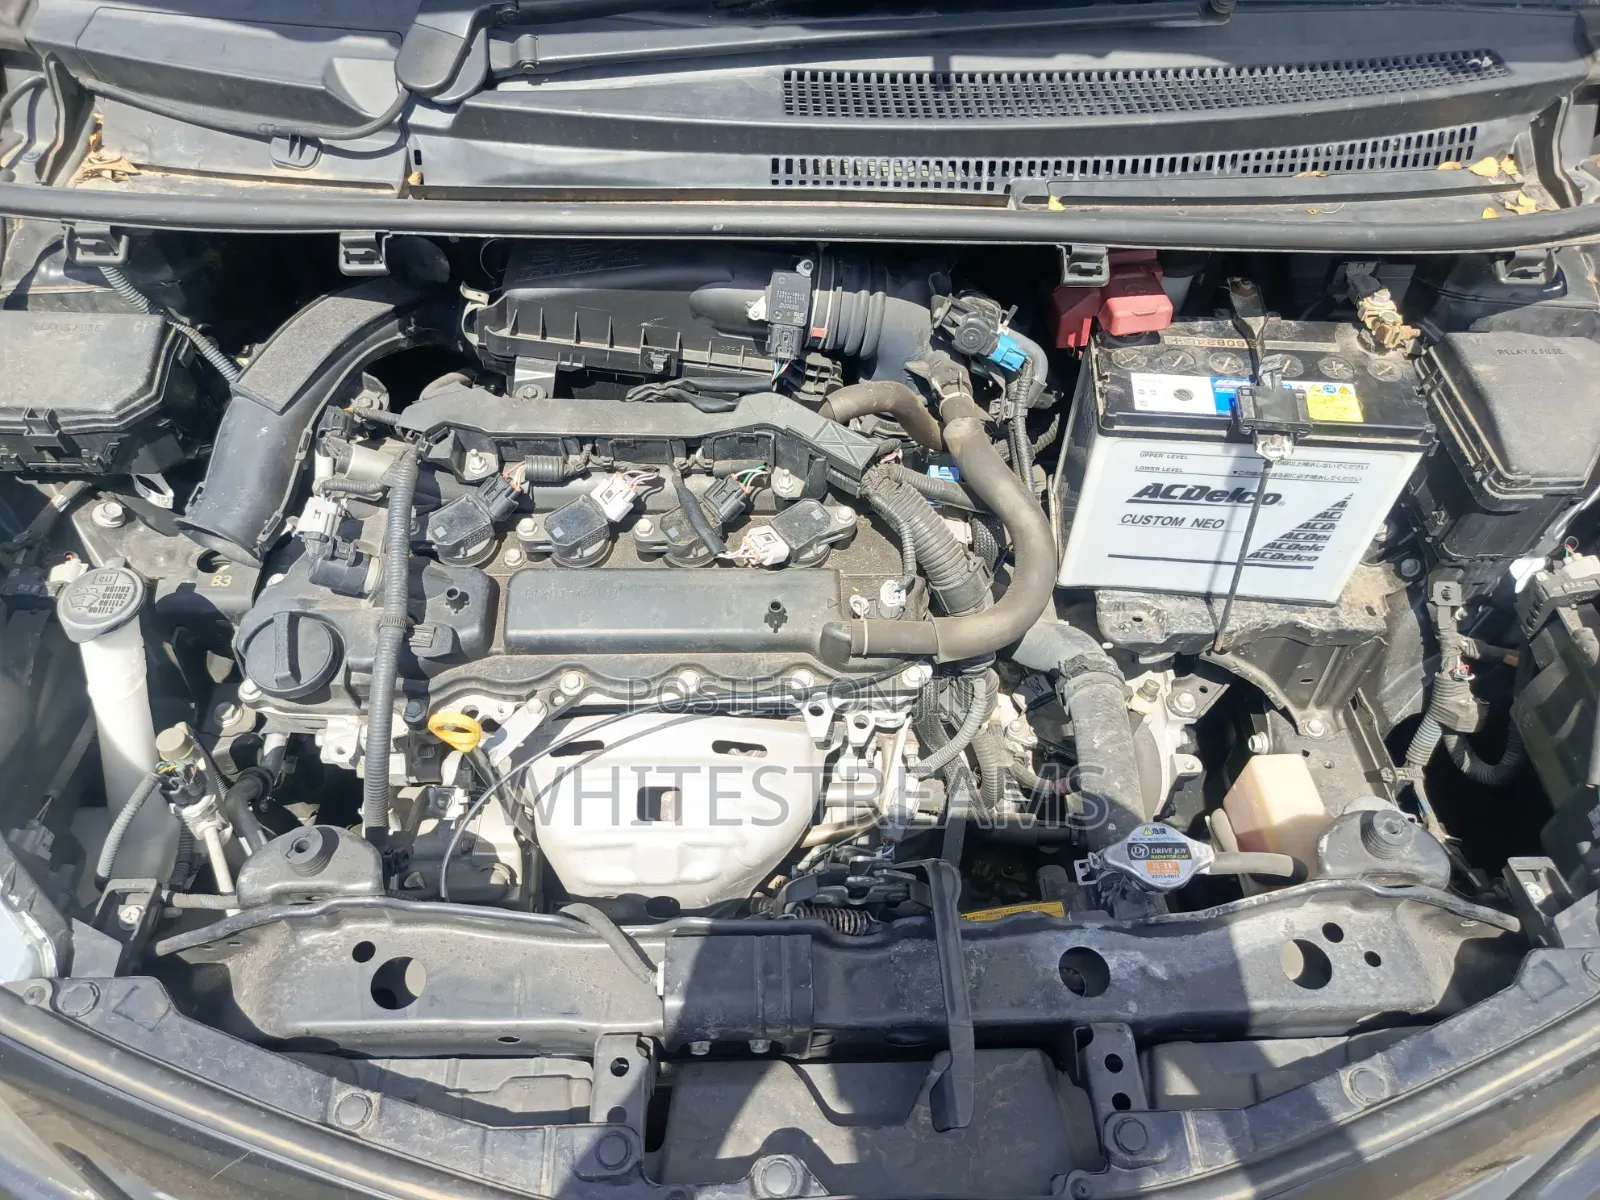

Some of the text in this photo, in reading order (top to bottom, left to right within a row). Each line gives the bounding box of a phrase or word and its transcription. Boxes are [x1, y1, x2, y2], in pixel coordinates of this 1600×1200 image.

[778, 302, 800, 311] DENSO
[73, 323, 102, 333] FUSE
[1497, 348, 1528, 356] RELAY
[1131, 482, 1283, 506] ACDelco
[1331, 500, 1348, 508] A
[1313, 511, 1343, 519] AC
[1120, 513, 1225, 529] CUSTOM NEO
[1295, 522, 1336, 530] ACD
[1262, 542, 1326, 551] ACDelc
[1247, 551, 1319, 562] ACDelco
[210, 574, 232, 587] 83
[1151, 827, 1168, 835] 危険
